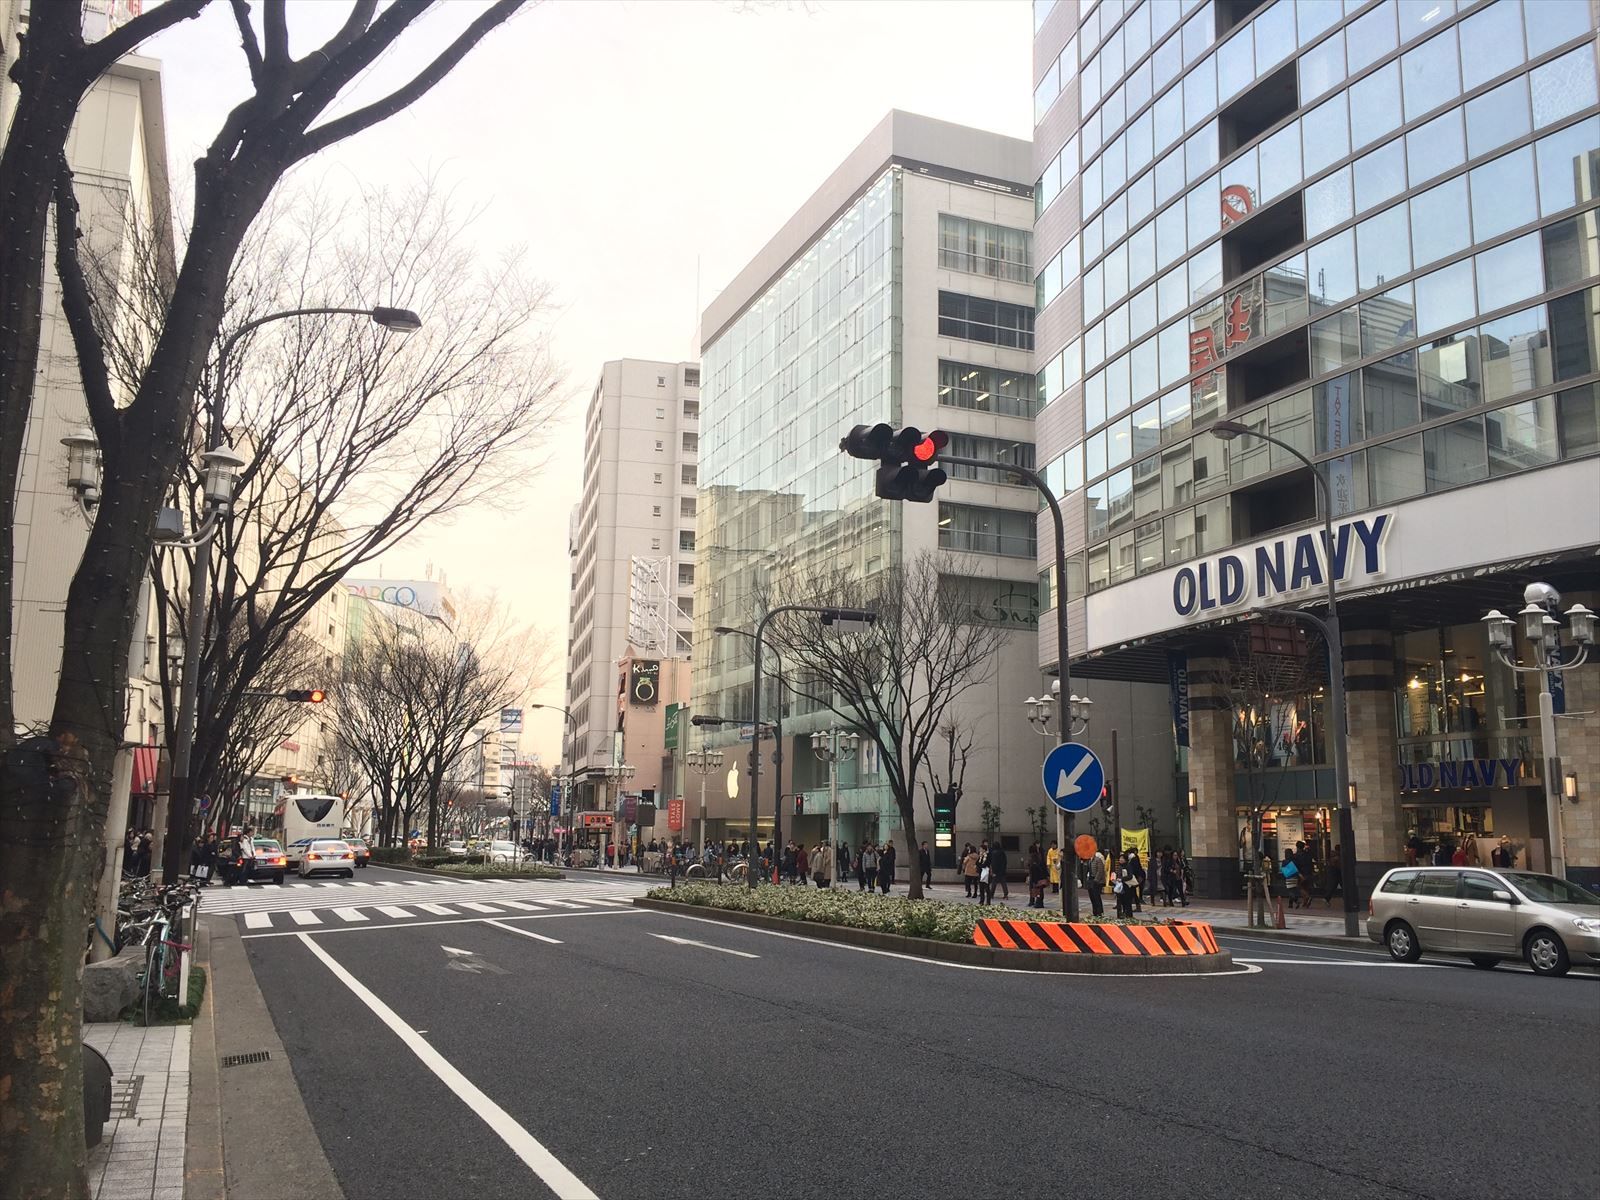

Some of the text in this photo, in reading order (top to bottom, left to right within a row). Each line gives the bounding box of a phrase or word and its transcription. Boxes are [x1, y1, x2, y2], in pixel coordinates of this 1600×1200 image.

[1173, 514, 1390, 617] OLD NAVY
[347, 584, 415, 607] PARCO
[1178, 668, 1188, 729] OLD NAVY
[1439, 758, 1520, 788] NAVY
